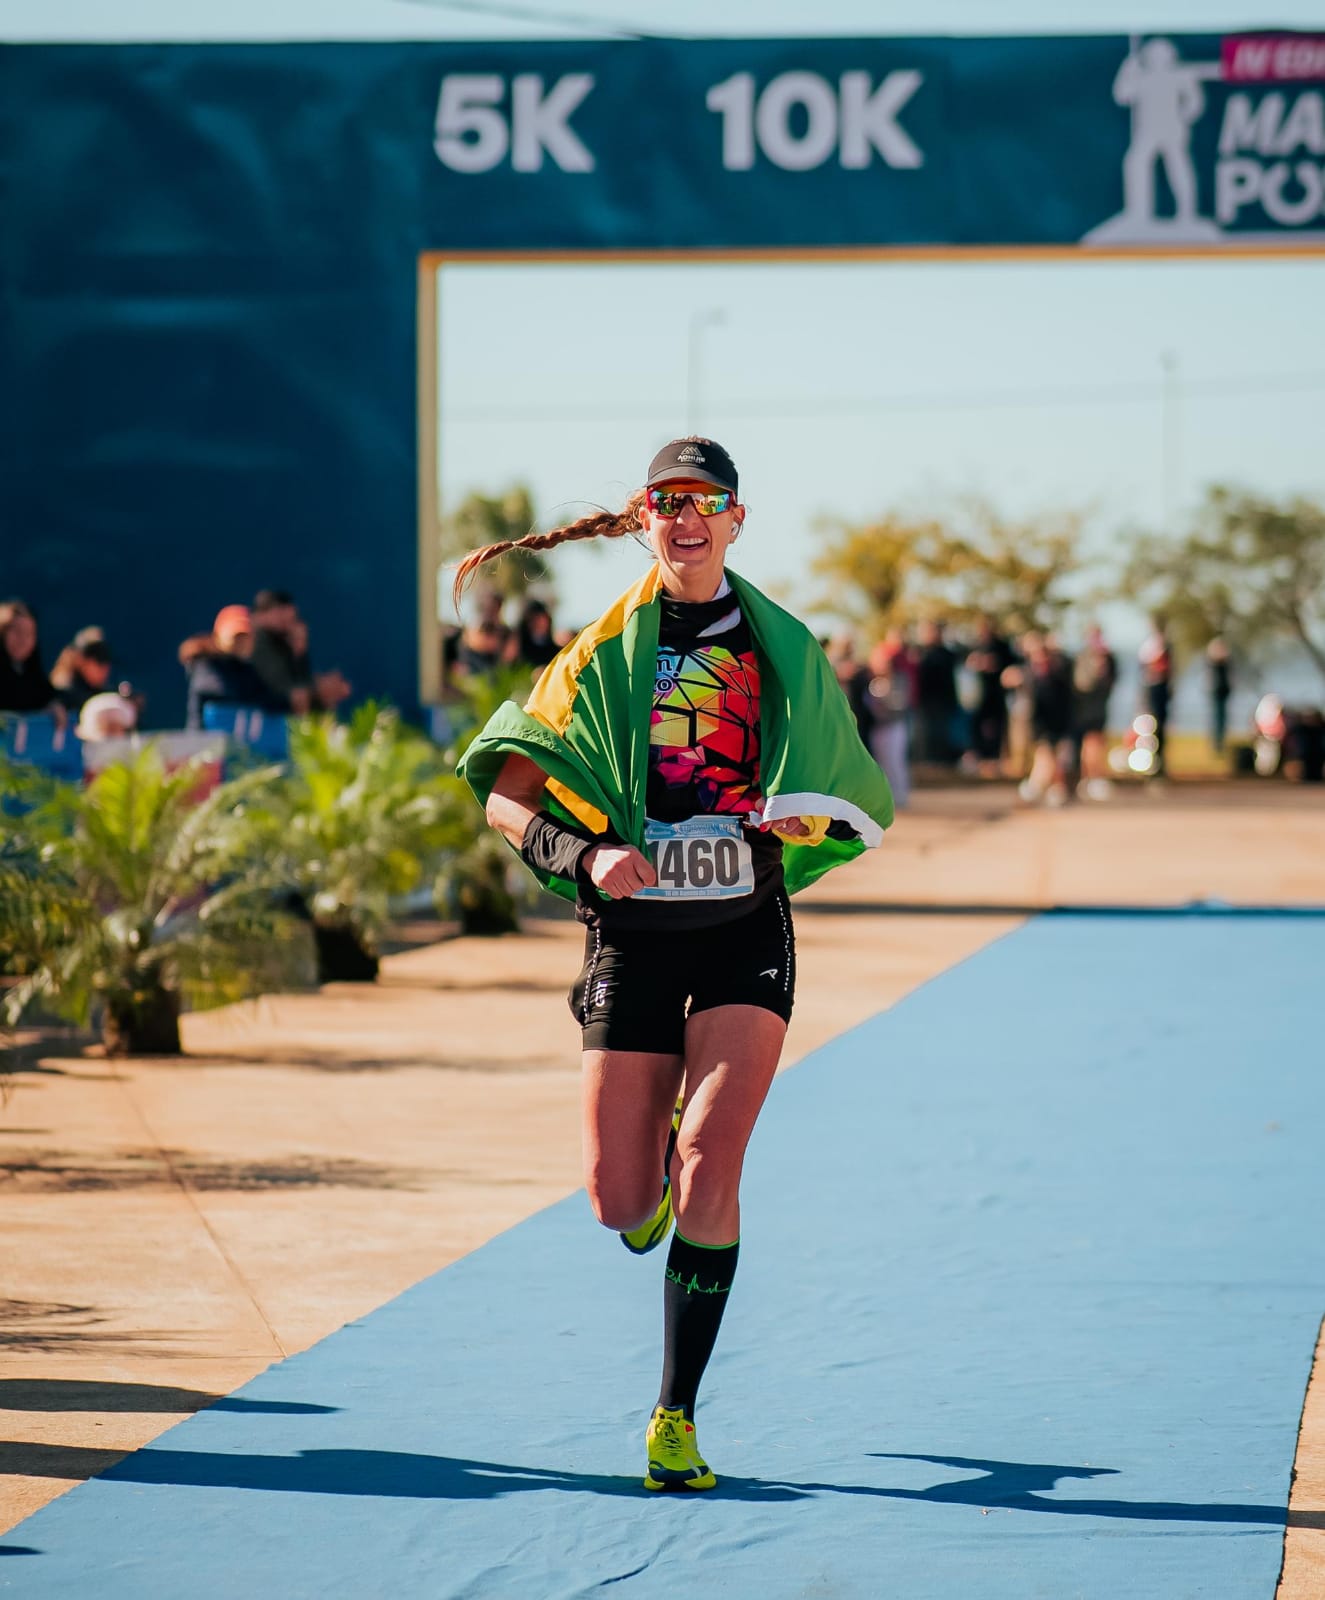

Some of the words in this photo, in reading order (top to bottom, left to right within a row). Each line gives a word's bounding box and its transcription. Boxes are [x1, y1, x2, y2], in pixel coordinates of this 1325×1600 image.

[433, 72, 595, 173] 5K
[705, 69, 924, 171] 10K
[1214, 155, 1325, 226] PO
[647, 838, 740, 888] 1460
